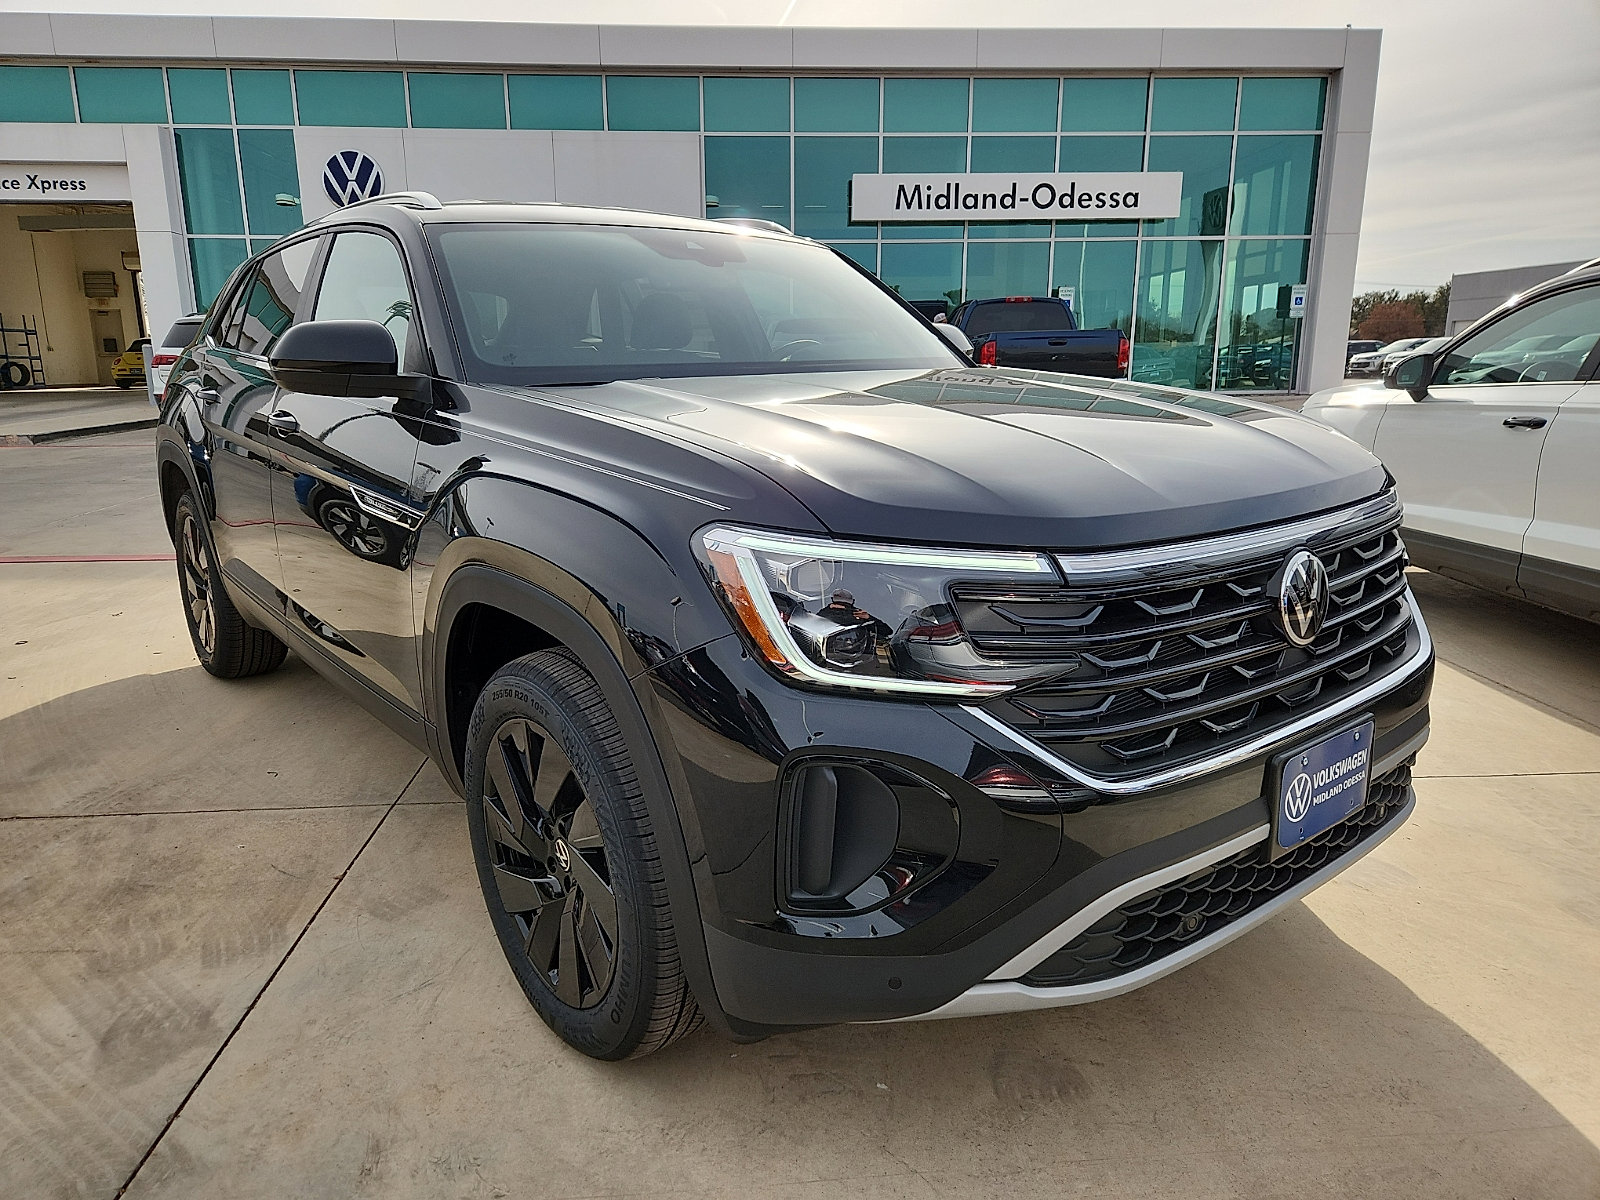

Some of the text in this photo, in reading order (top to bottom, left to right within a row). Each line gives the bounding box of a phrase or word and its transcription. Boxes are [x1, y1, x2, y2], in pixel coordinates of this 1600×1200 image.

[25, 174, 87, 194] Xpress
[895, 181, 1140, 211] Midland-Odessa
[514, 689, 529, 703] R20
[1313, 748, 1368, 790] VOLKSWAGEN
[1285, 773, 1312, 822] VW
[1312, 770, 1366, 807] MIDLAND ODESSA
